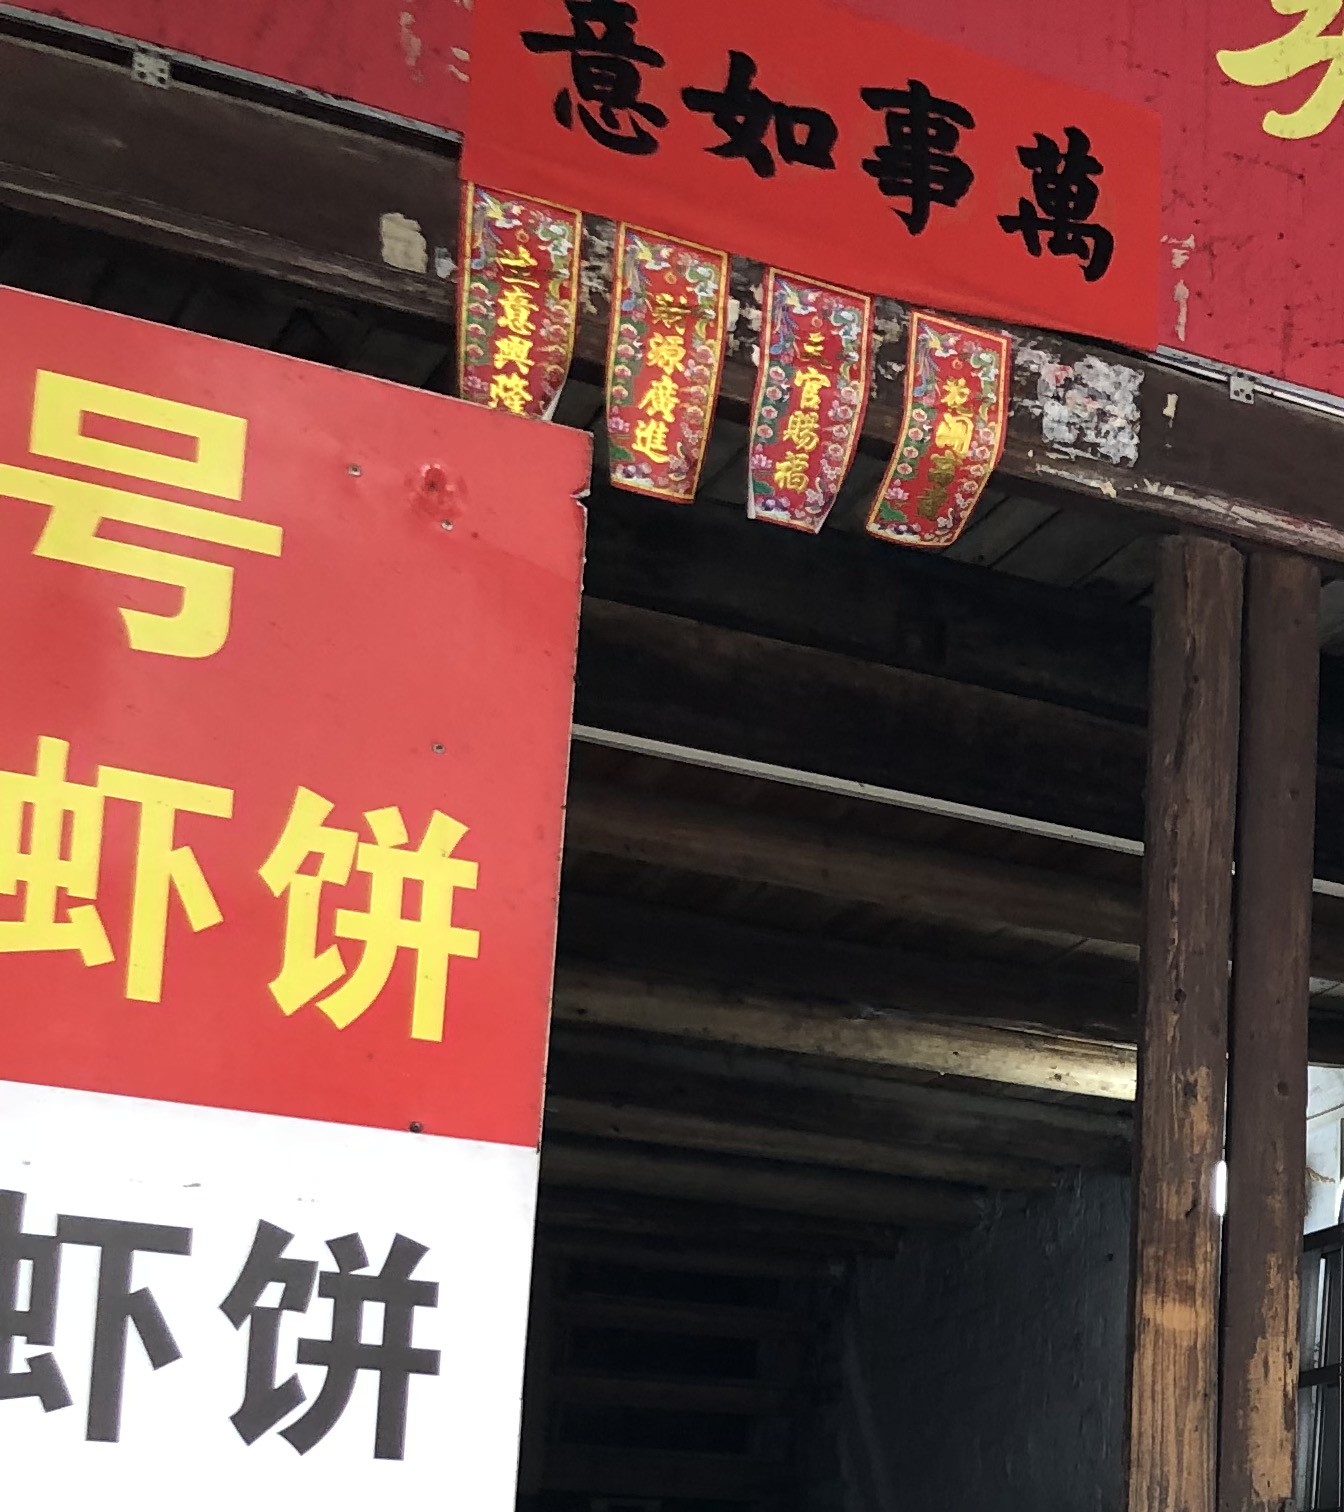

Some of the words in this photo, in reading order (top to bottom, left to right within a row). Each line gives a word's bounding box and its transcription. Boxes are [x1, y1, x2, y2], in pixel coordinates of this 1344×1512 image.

[0, 368, 284, 659] 号
[0, 735, 481, 1043] 虾饼
[0, 1188, 442, 1461] 虾饼
